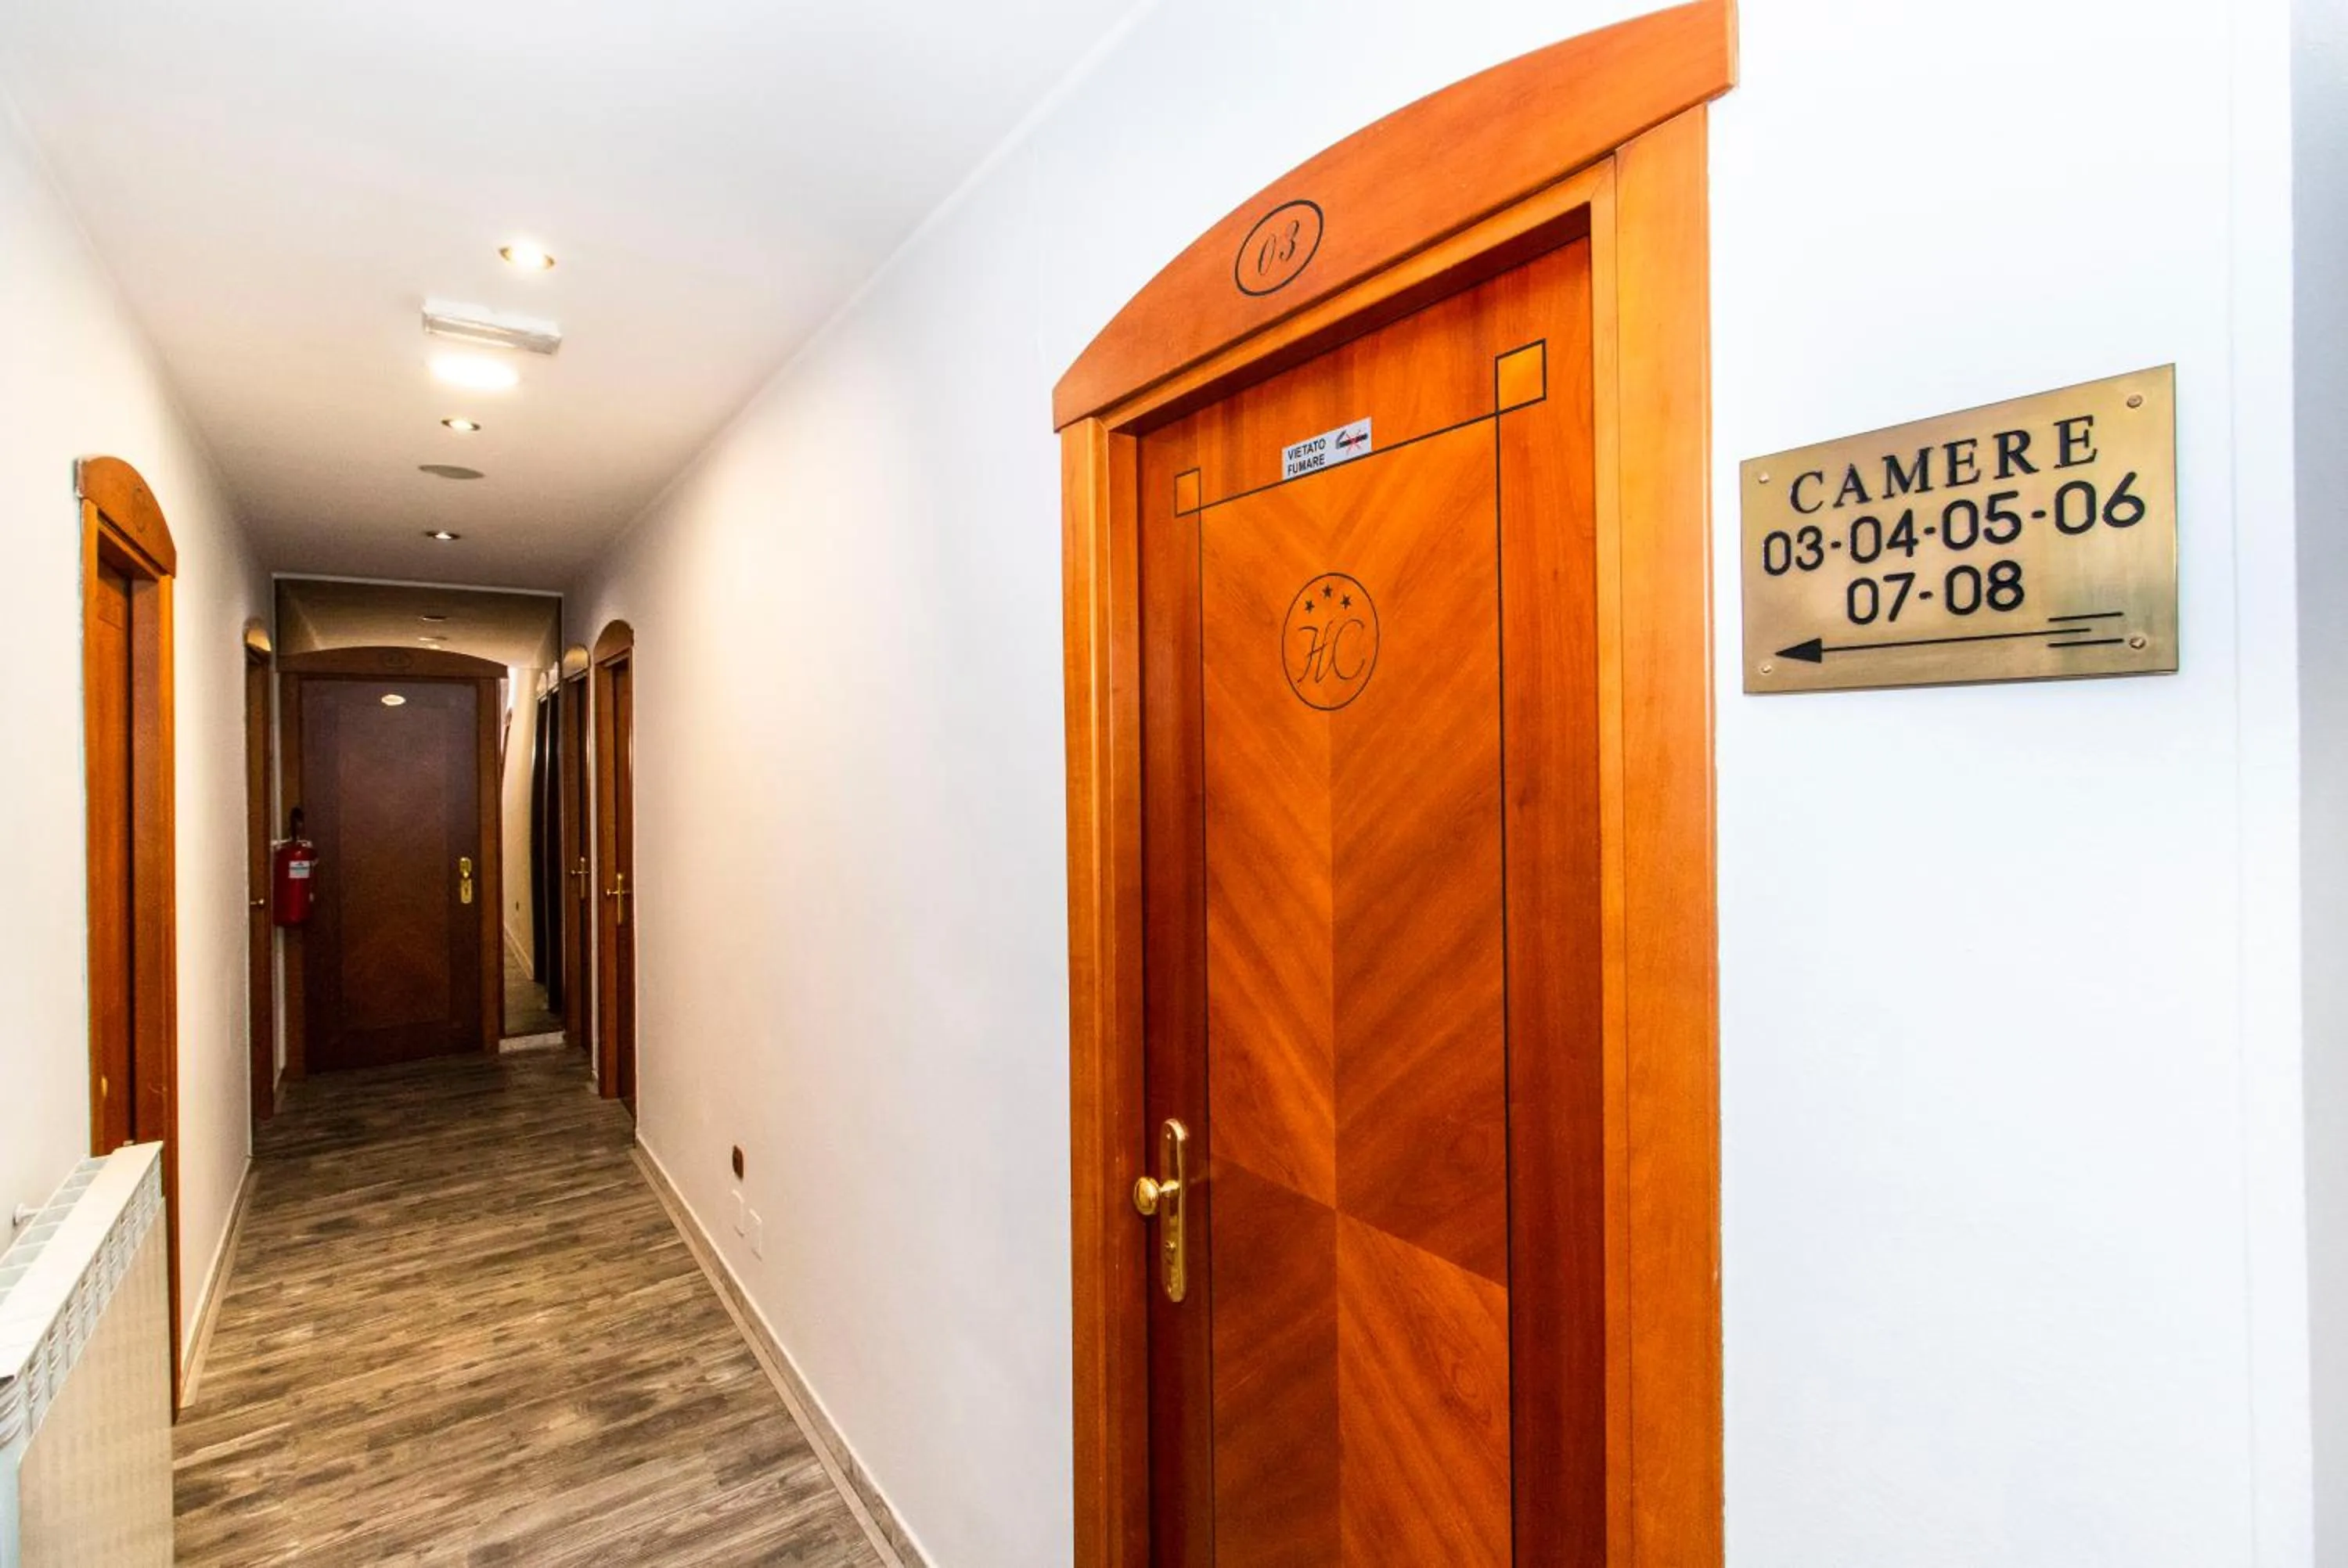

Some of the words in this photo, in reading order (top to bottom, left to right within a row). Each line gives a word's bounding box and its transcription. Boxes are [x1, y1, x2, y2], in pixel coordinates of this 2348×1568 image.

[1258, 220, 1300, 275] 03
[1287, 438, 1327, 460] VIETATO
[1287, 454, 1326, 477] FUMARE
[1790, 415, 2098, 513] CAMERE
